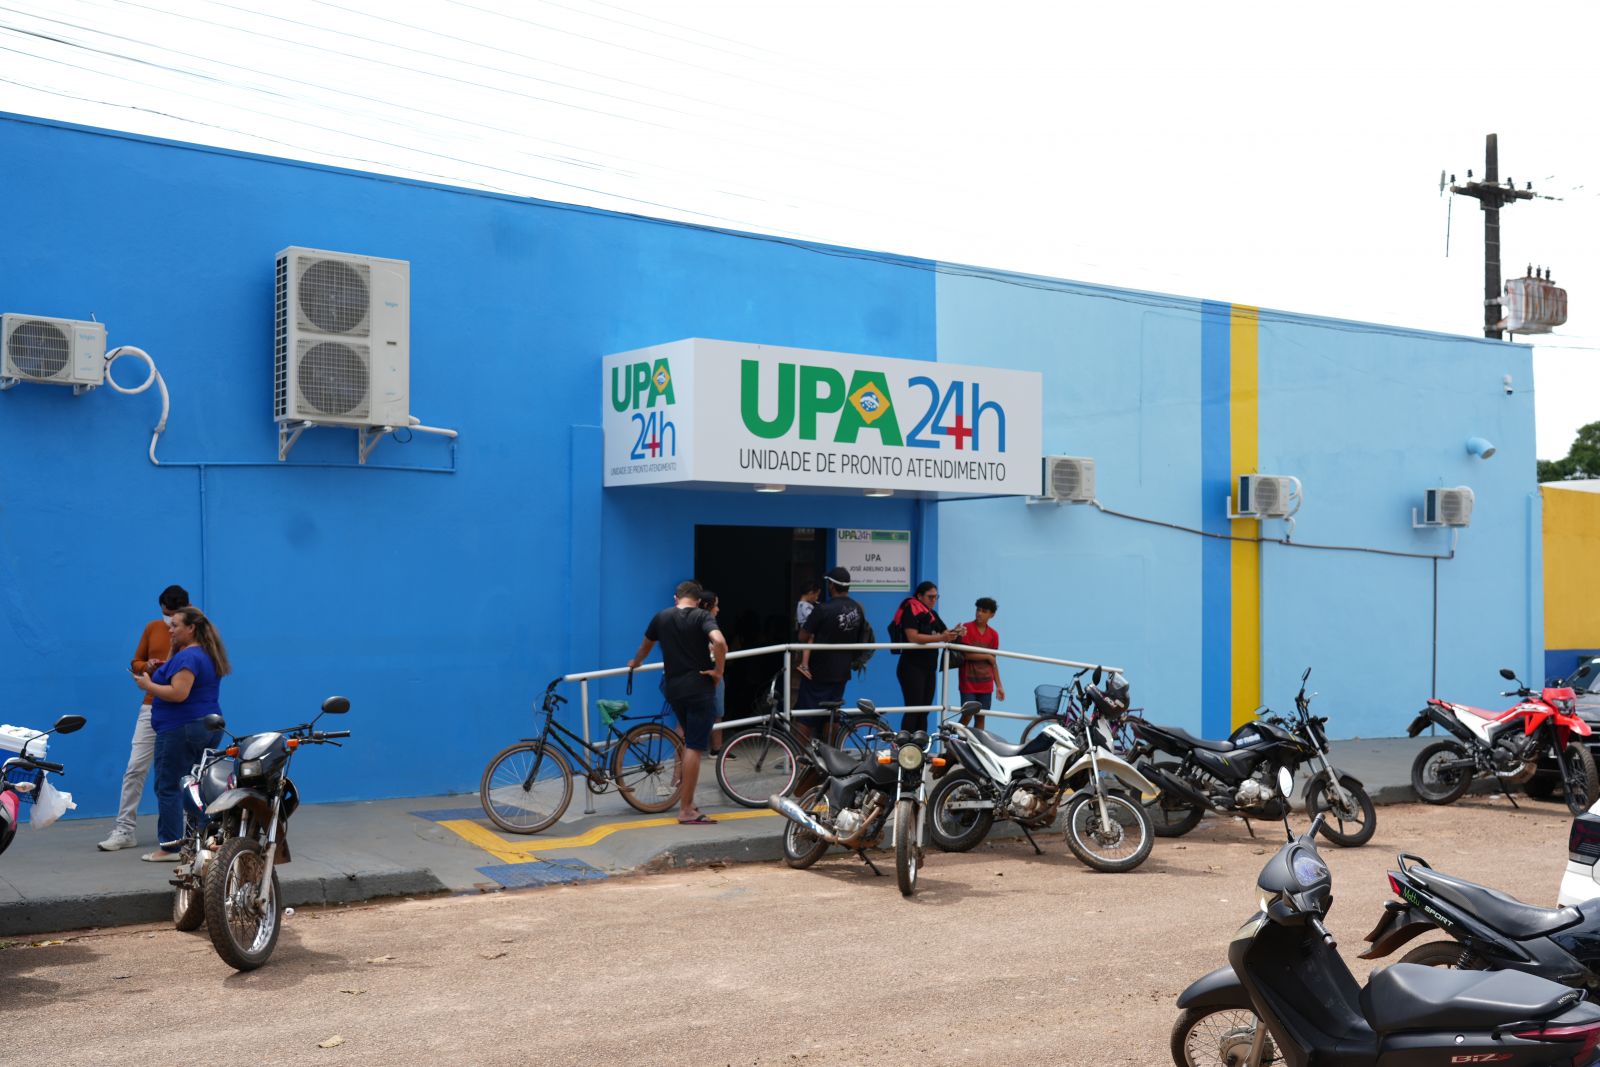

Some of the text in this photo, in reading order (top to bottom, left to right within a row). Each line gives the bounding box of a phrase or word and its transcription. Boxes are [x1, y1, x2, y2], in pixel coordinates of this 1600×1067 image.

[611, 357, 676, 413] UPA
[740, 359, 1006, 453] UPA 24h
[630, 410, 676, 461] 24h
[611, 465, 627, 476] UNIDADE
[633, 464, 648, 474] PRONTO
[648, 462, 677, 473] ATENDIMENTO
[739, 447, 1007, 482] UNIDADE DE PRONTO ATENDIMENTO
[865, 553, 882, 562] UPA
[1424, 905, 1454, 927] SPORT
[1557, 993, 1578, 1004] HONDA
